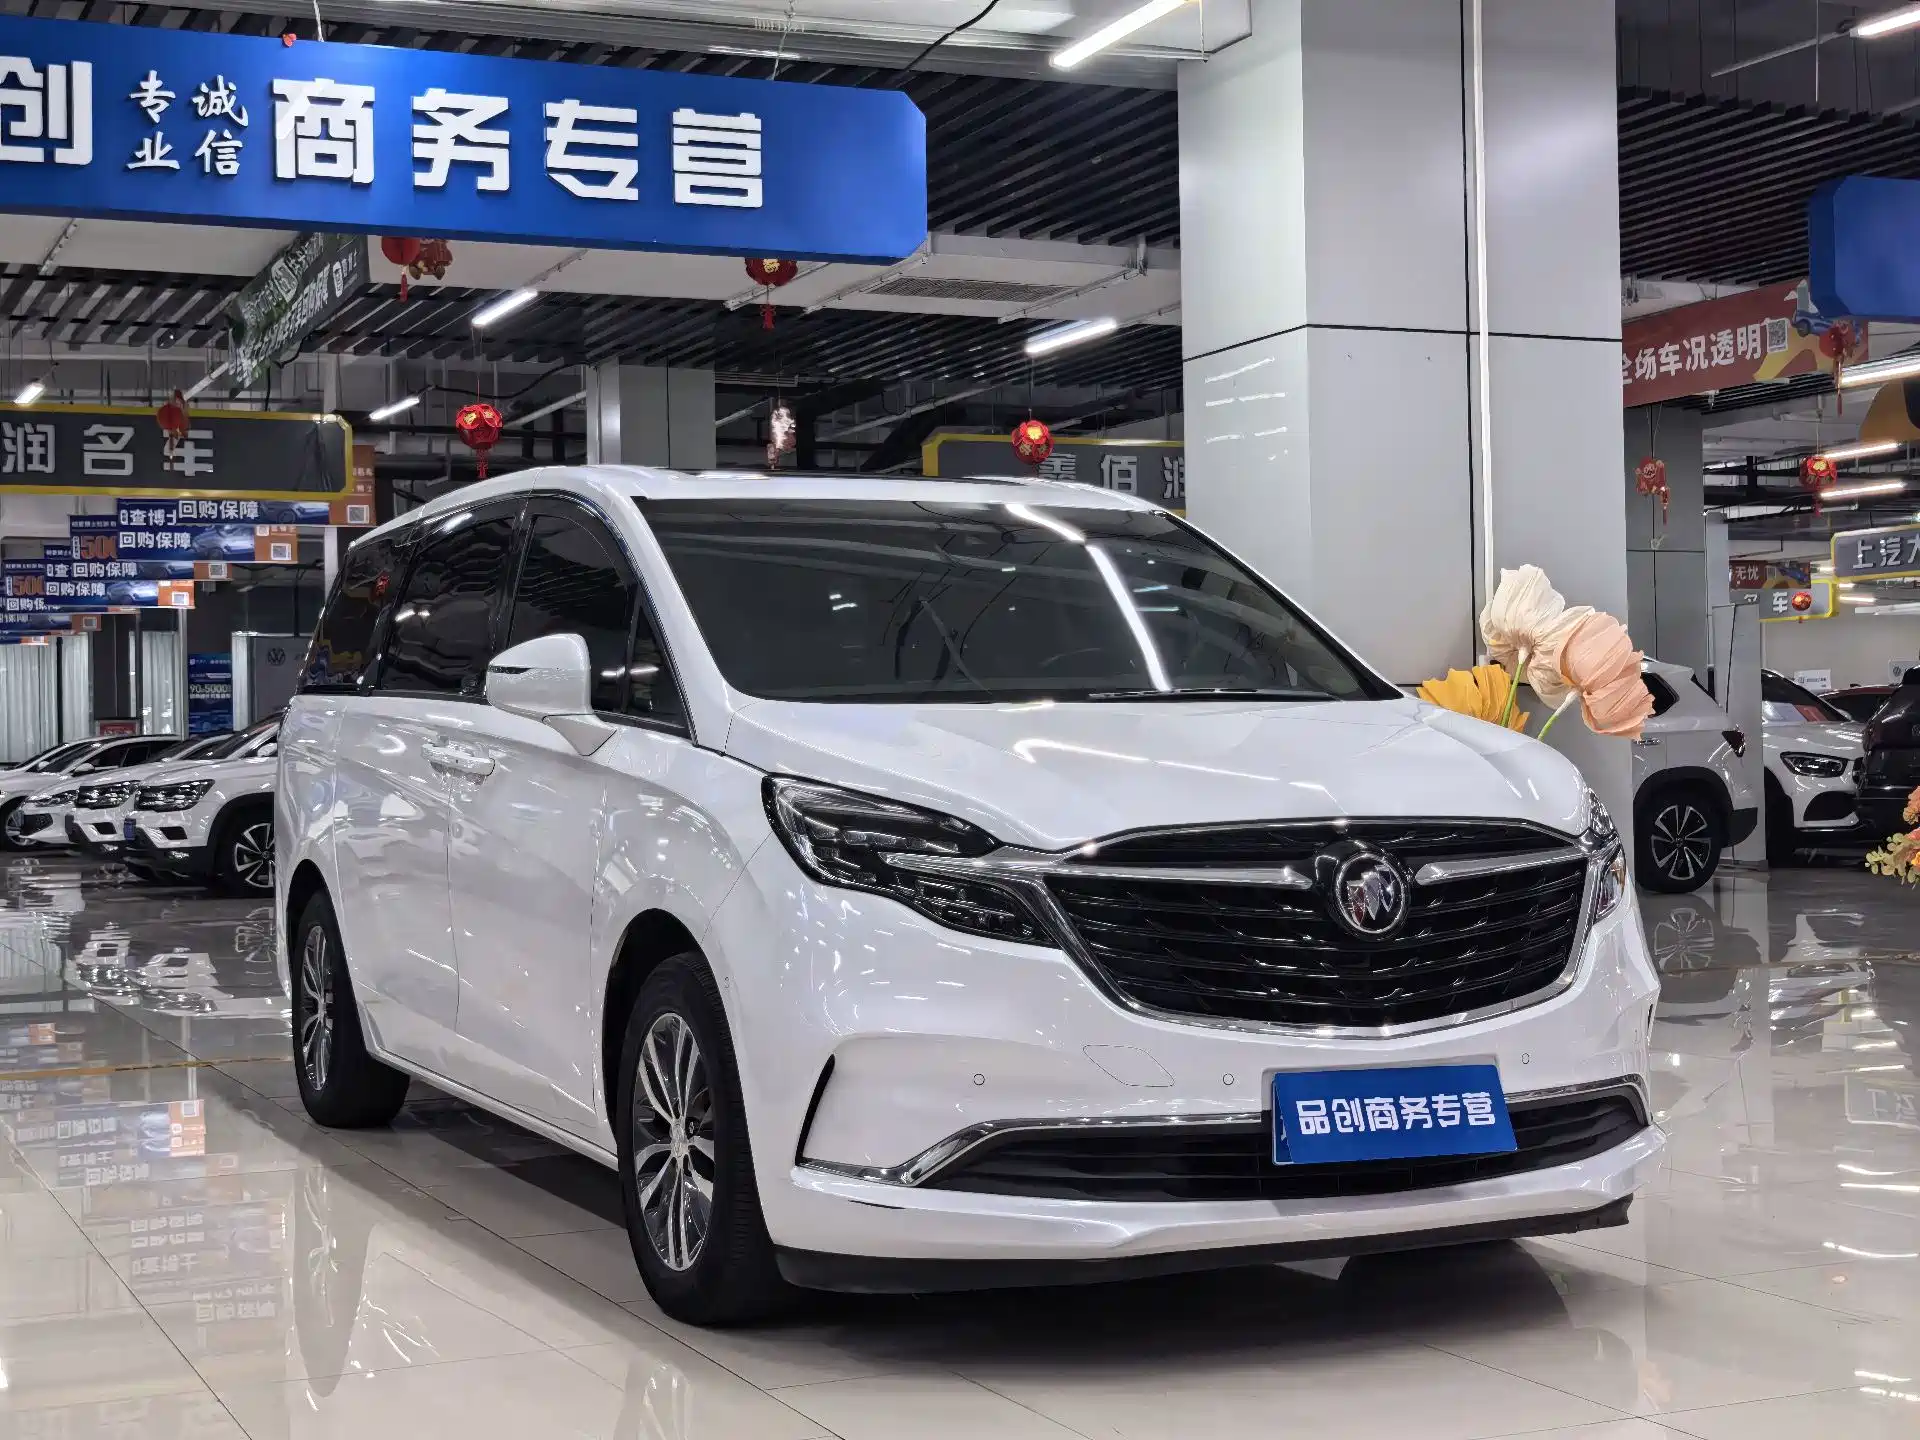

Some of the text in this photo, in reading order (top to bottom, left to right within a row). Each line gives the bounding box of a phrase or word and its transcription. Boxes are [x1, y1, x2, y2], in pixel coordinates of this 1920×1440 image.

[0, 56, 93, 166] 创
[272, 77, 764, 209] 商务专营
[2, 421, 214, 477] 润名车
[179, 500, 259, 520] 回购保障
[119, 532, 191, 549] 回购保障
[73, 562, 138, 578] 回购保障
[46, 582, 106, 597] 回购保障
[1296, 1092, 1496, 1135] 品创商务专营
